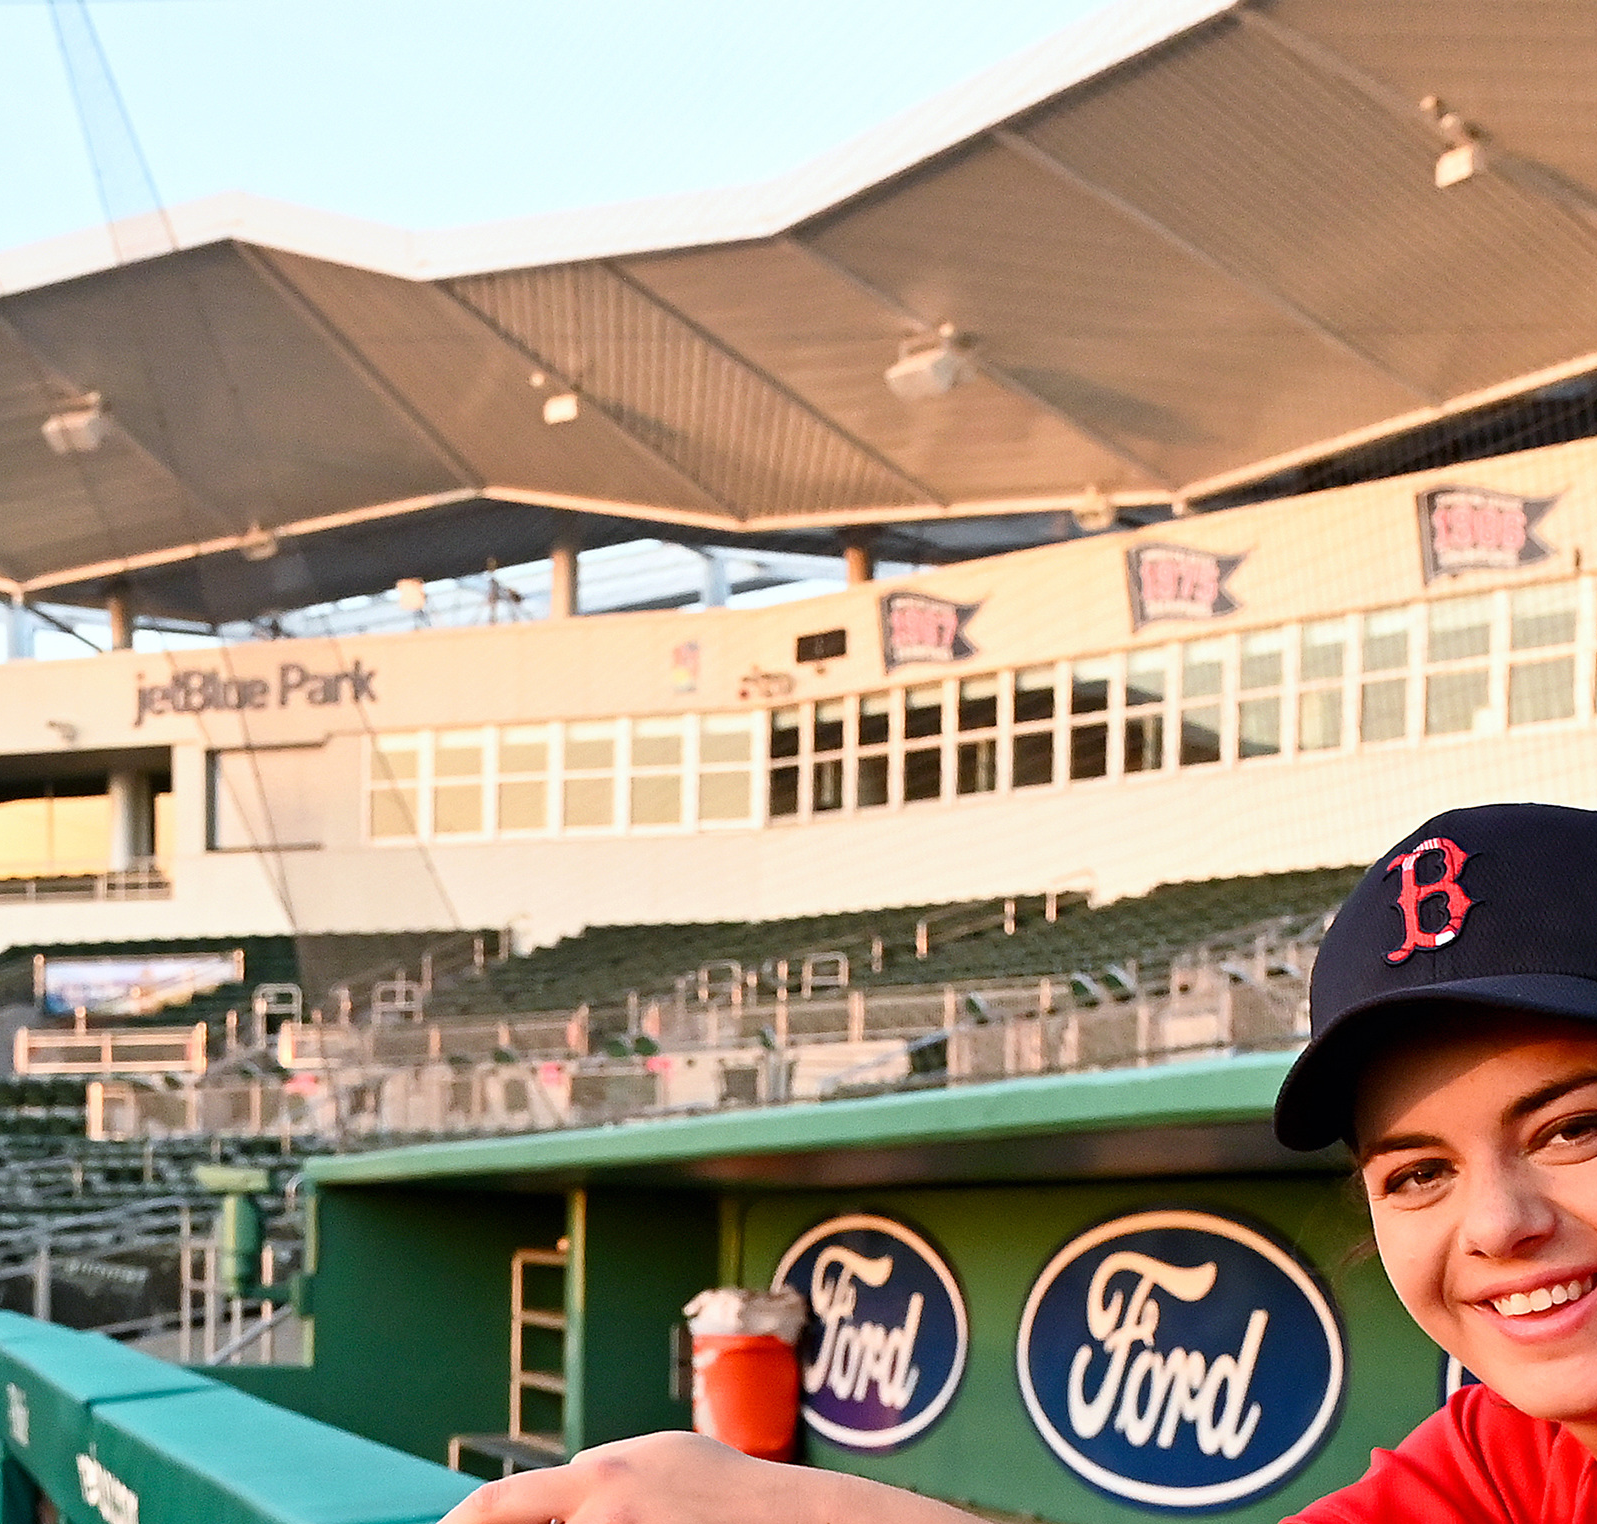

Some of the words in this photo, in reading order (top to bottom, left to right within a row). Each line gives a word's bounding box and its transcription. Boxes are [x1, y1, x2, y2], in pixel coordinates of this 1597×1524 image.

[133, 669, 270, 729] jetBlue
[279, 660, 378, 707] Park
[1381, 836, 1485, 966] B
[805, 1244, 924, 1410] Ford
[1067, 1250, 1269, 1460] Ford
